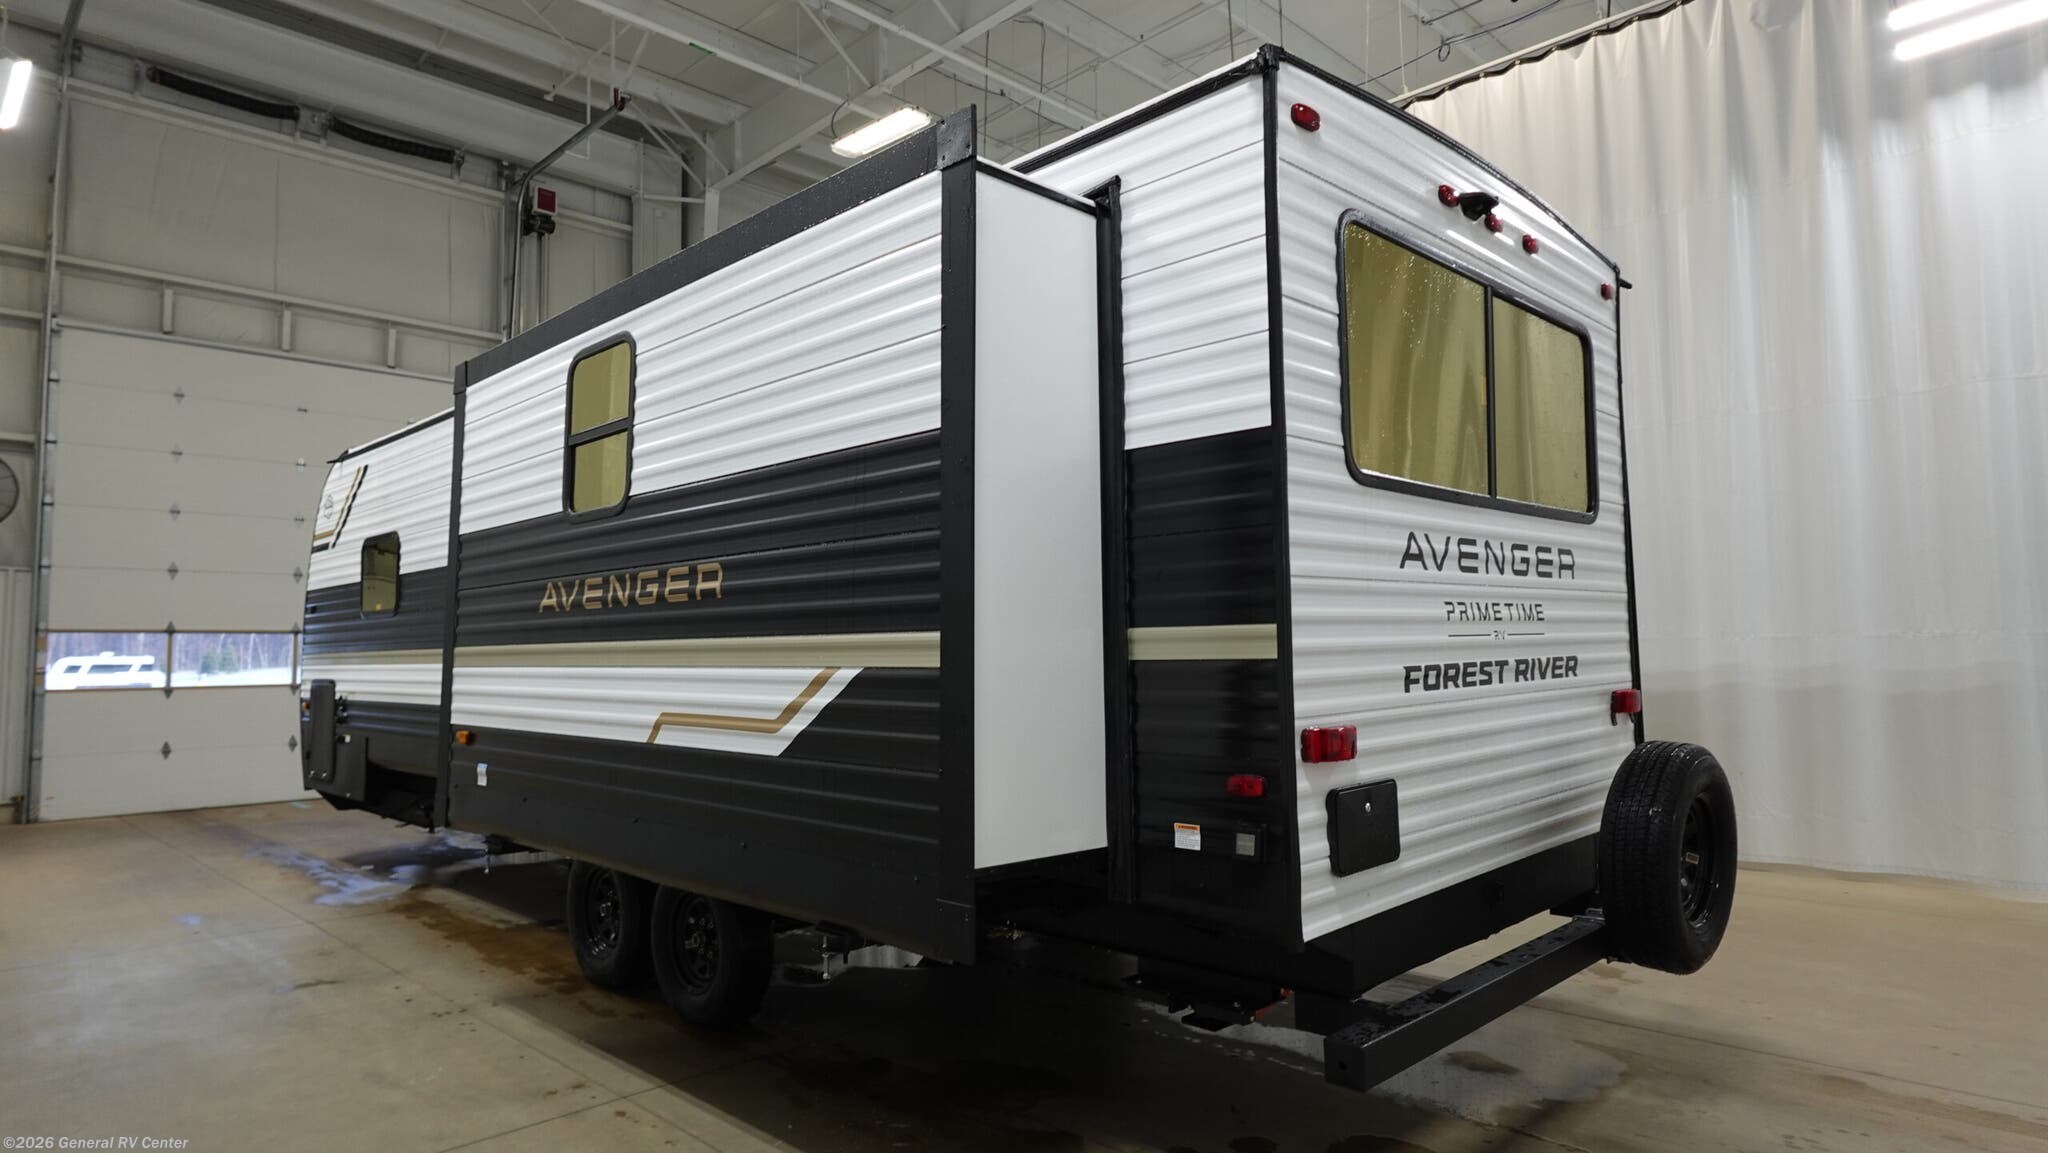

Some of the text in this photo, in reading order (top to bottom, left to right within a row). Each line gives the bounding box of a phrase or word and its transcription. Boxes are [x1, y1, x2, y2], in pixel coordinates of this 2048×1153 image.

[1400, 531, 1575, 579] AVENGER
[538, 562, 723, 613] AVENGER
[1493, 630, 1506, 640] RV
[1403, 655, 1578, 693] FOREST RIVER
